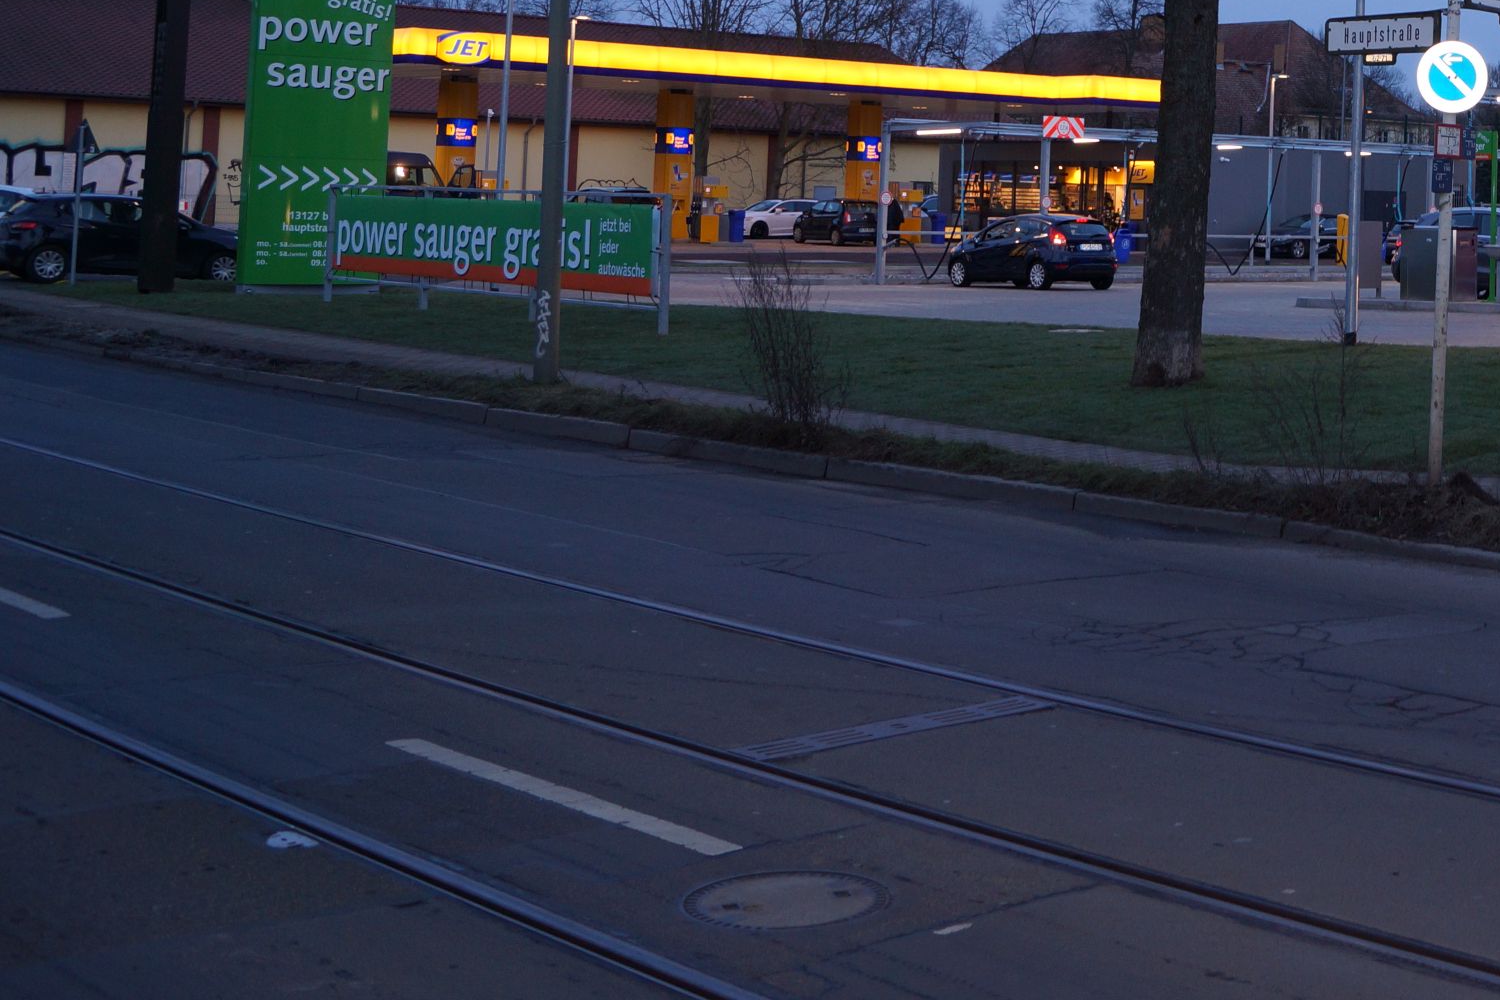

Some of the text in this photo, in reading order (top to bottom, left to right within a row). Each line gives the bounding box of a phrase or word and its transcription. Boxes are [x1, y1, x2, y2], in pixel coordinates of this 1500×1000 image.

[258, 15, 379, 50] power
[1343, 26, 1420, 47] Hauptstraße
[445, 39, 488, 57] JET
[267, 62, 391, 99] sauger
[282, 222, 328, 233] hauptstra
[599, 218, 632, 236] jetzt bei
[336, 218, 591, 280] power sauger grais!
[598, 239, 619, 257] jeder
[598, 262, 646, 278] autowäsche
